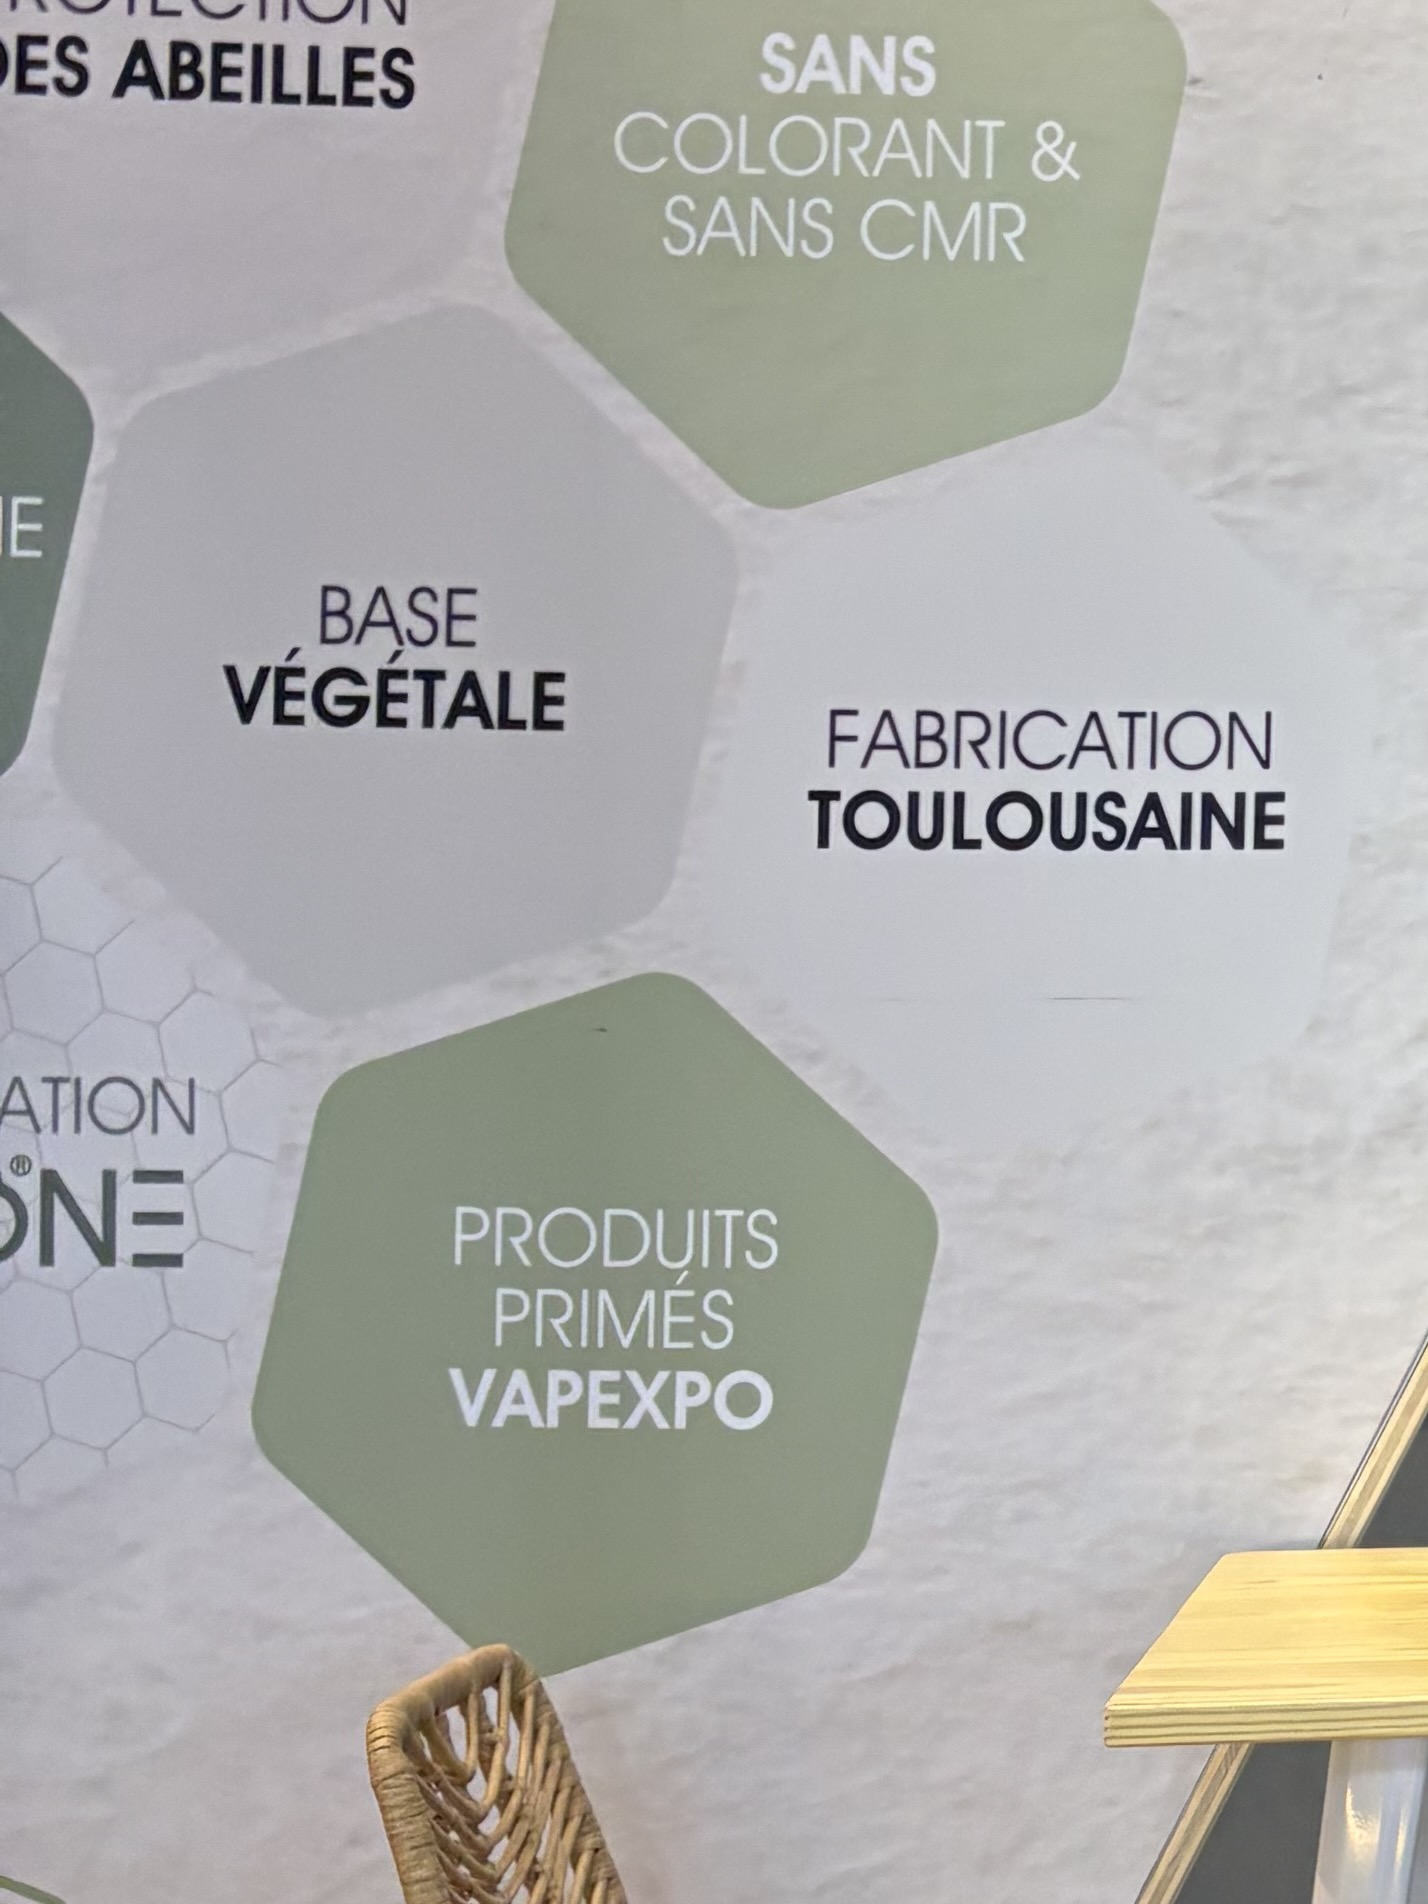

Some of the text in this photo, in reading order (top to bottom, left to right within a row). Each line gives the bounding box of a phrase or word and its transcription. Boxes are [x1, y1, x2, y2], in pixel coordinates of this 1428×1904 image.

[0, 34, 416, 109] ES ABEILLES
[759, 32, 936, 96] SANS
[614, 111, 1080, 182] COLORANT &
[662, 195, 1027, 262] SANS CMR
[319, 584, 478, 648] BASE
[222, 647, 566, 731] VÉGÉTALE
[827, 709, 1272, 770] FABRICATION
[808, 789, 1286, 851] TOULOUSAINE
[454, 1206, 779, 1269] PRODUITS
[494, 1270, 735, 1350] PRIMÉS
[448, 1367, 774, 1431] VAPEXPO
